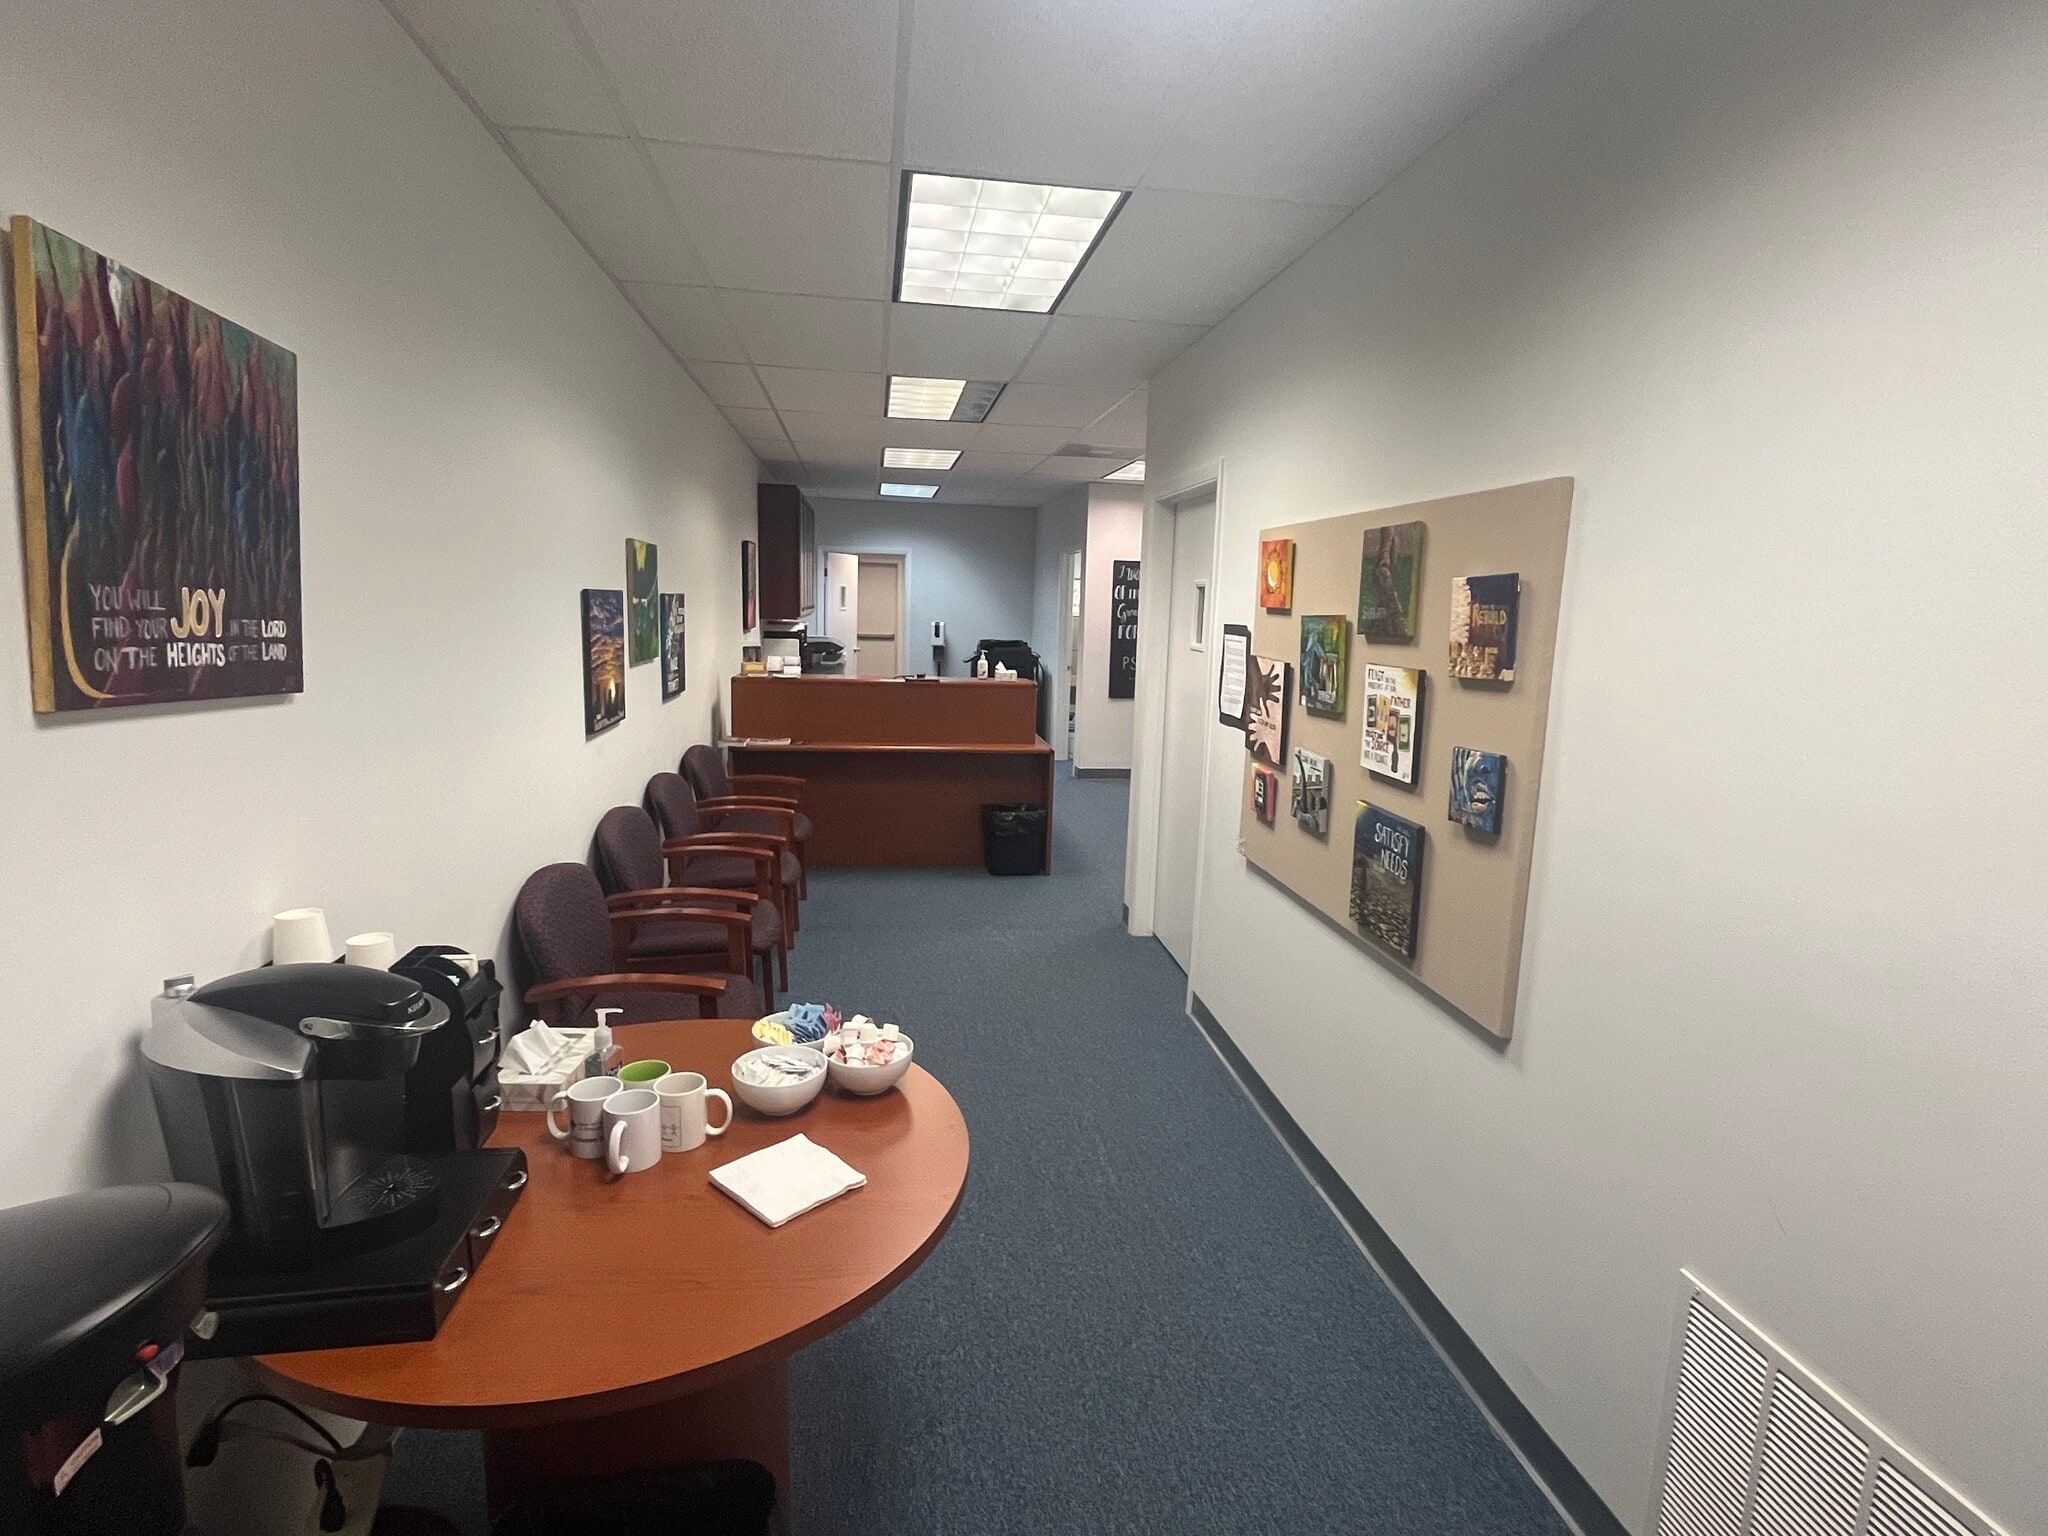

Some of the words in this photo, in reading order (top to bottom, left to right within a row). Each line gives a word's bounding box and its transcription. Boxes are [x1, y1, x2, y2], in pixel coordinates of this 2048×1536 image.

[89, 583, 123, 611] YOU
[127, 589, 166, 611] WILL
[92, 616, 130, 640] FIND
[134, 617, 169, 640] YOUR
[170, 586, 226, 639] JOY
[261, 619, 287, 638] LORD
[94, 647, 119, 674] ON
[120, 646, 158, 670] THE
[167, 642, 226, 668] HEIGHTS
[261, 641, 287, 661] LAND
[1374, 822, 1409, 858] SATISFY
[1380, 848, 1408, 880] NEEDS
